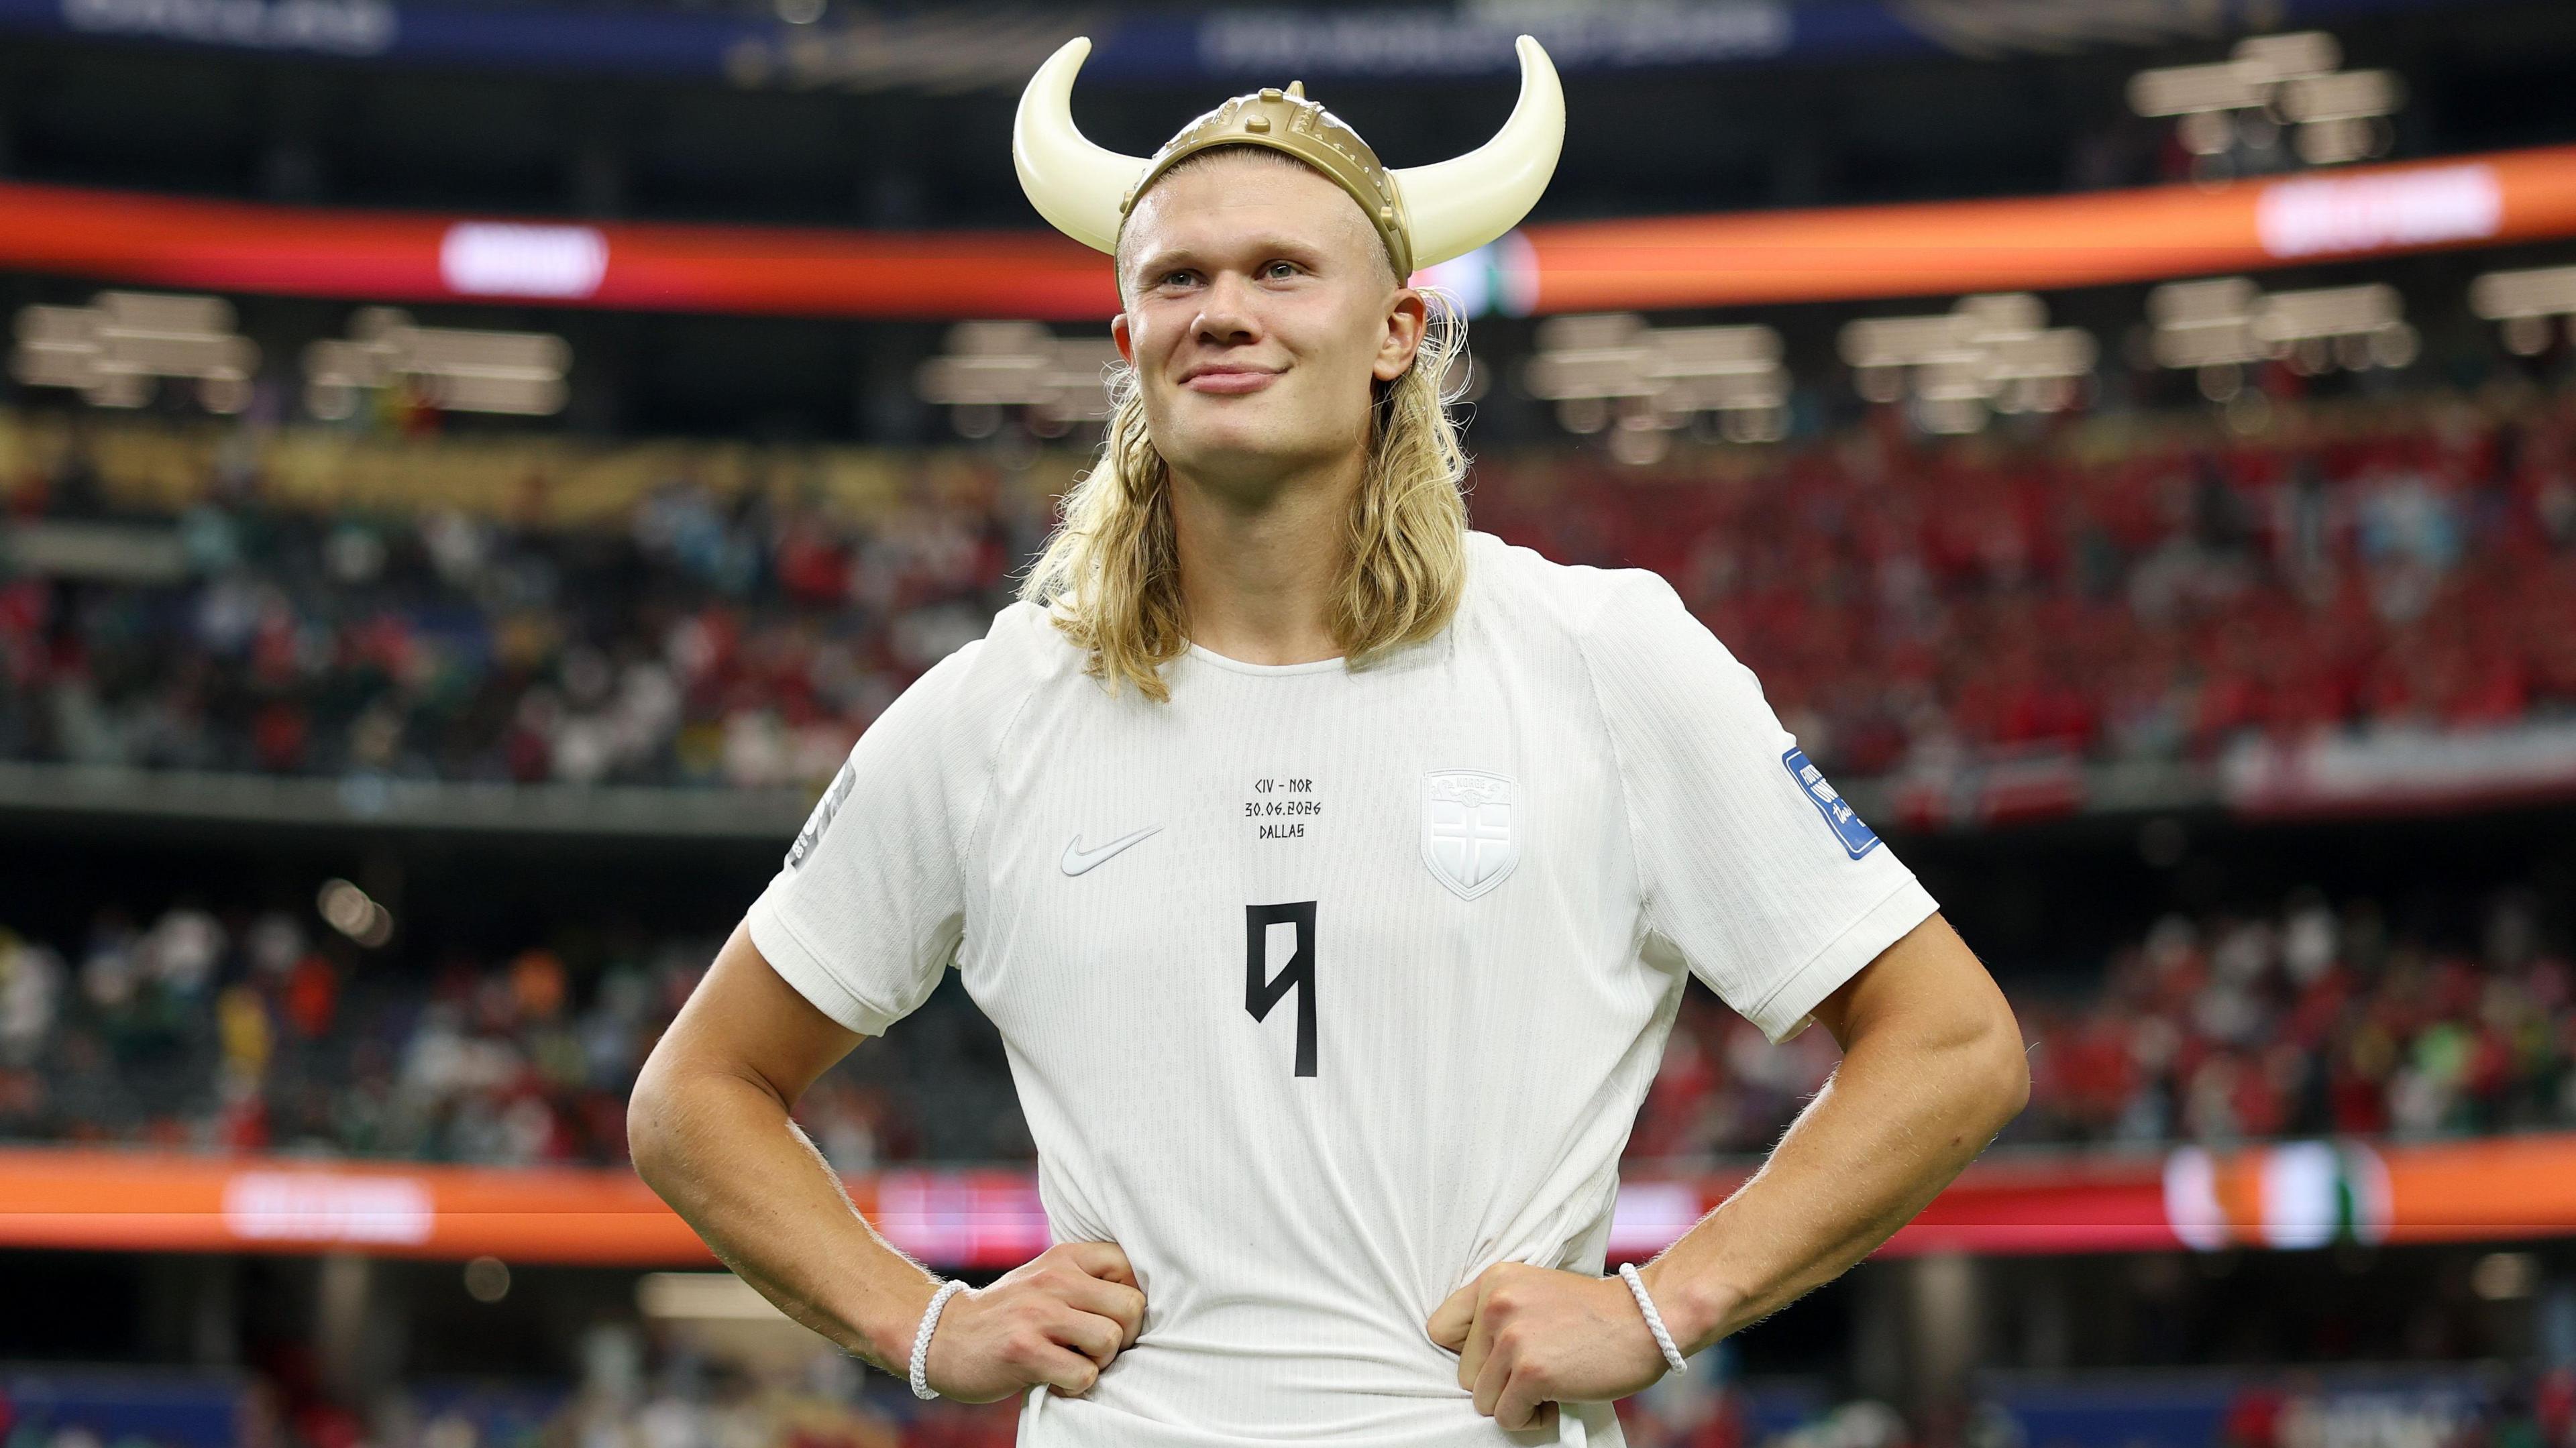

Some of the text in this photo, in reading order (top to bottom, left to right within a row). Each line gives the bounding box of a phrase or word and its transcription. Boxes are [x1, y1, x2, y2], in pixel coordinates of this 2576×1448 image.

[1254, 779, 1274, 793] CIV
[1289, 779, 1313, 793] NOR
[1245, 801, 1322, 817] 30.06.2026
[1259, 824, 1304, 839] DALLAS
[1245, 901, 1317, 1077] 9
